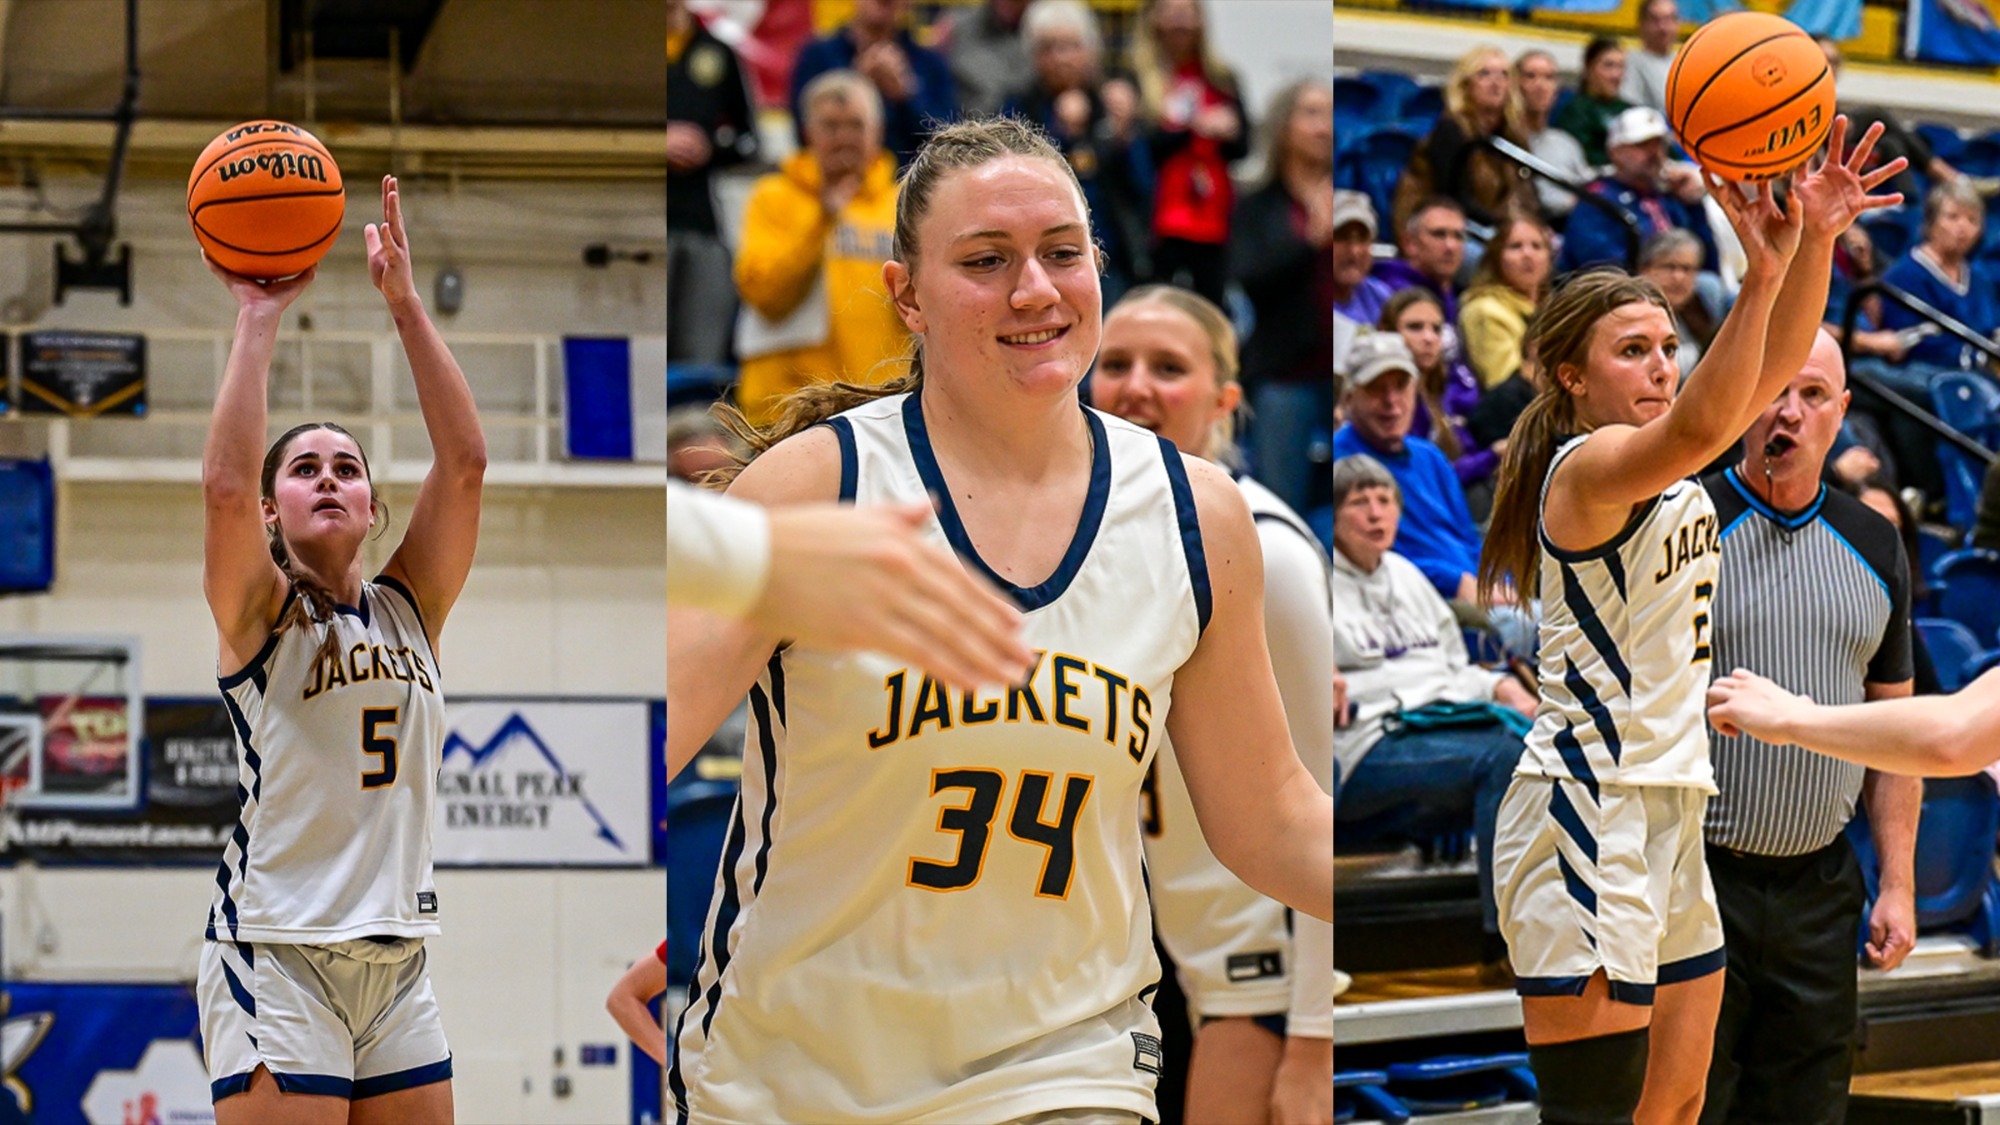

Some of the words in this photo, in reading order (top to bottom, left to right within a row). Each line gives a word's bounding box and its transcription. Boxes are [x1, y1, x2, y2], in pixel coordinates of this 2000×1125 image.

[226, 123, 303, 143] NCAA
[216, 152, 327, 183] Wilson
[1655, 513, 1720, 584] JACK
[302, 642, 435, 700] JACKETS
[361, 706, 399, 791] 5
[436, 772, 504, 796] GNAL
[516, 772, 584, 797] PEAK
[446, 803, 549, 828] ENERGY
[906, 767, 1095, 901] 34
